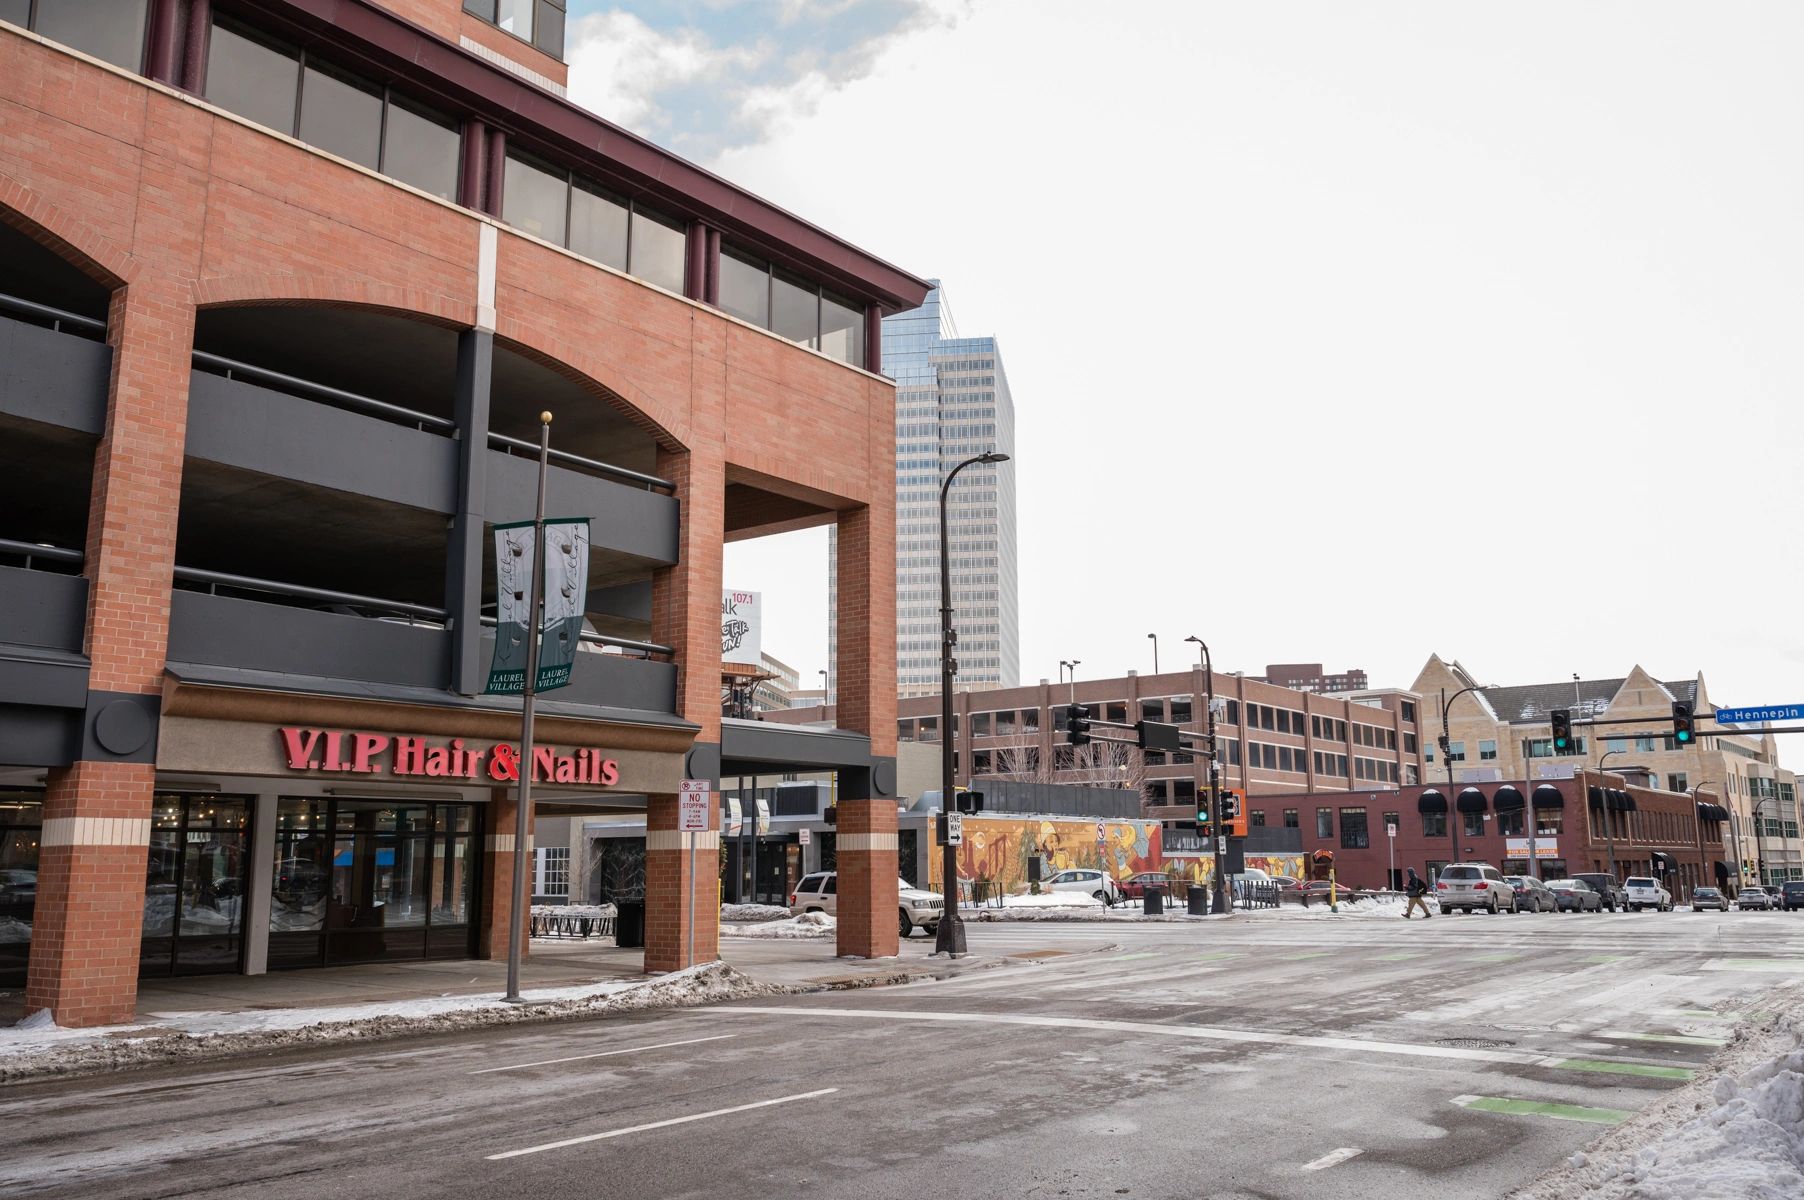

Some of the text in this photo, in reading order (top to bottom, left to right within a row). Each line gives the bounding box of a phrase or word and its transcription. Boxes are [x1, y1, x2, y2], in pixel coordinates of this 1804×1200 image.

[732, 592, 753, 605] 107.1
[721, 634, 742, 654] UN!
[493, 673, 525, 682] LAUREL
[542, 668, 569, 679] LAUREL
[489, 682, 525, 691] VILLAGE
[538, 674, 569, 688] VILLAGE
[1734, 707, 1799, 720] Hennepin
[391, 734, 485, 778] Hair
[487, 743, 522, 781] &
[531, 746, 620, 786] Nails
[689, 793, 701, 802] NO
[950, 815, 960, 823] ONE
[950, 823, 960, 831] WAY
